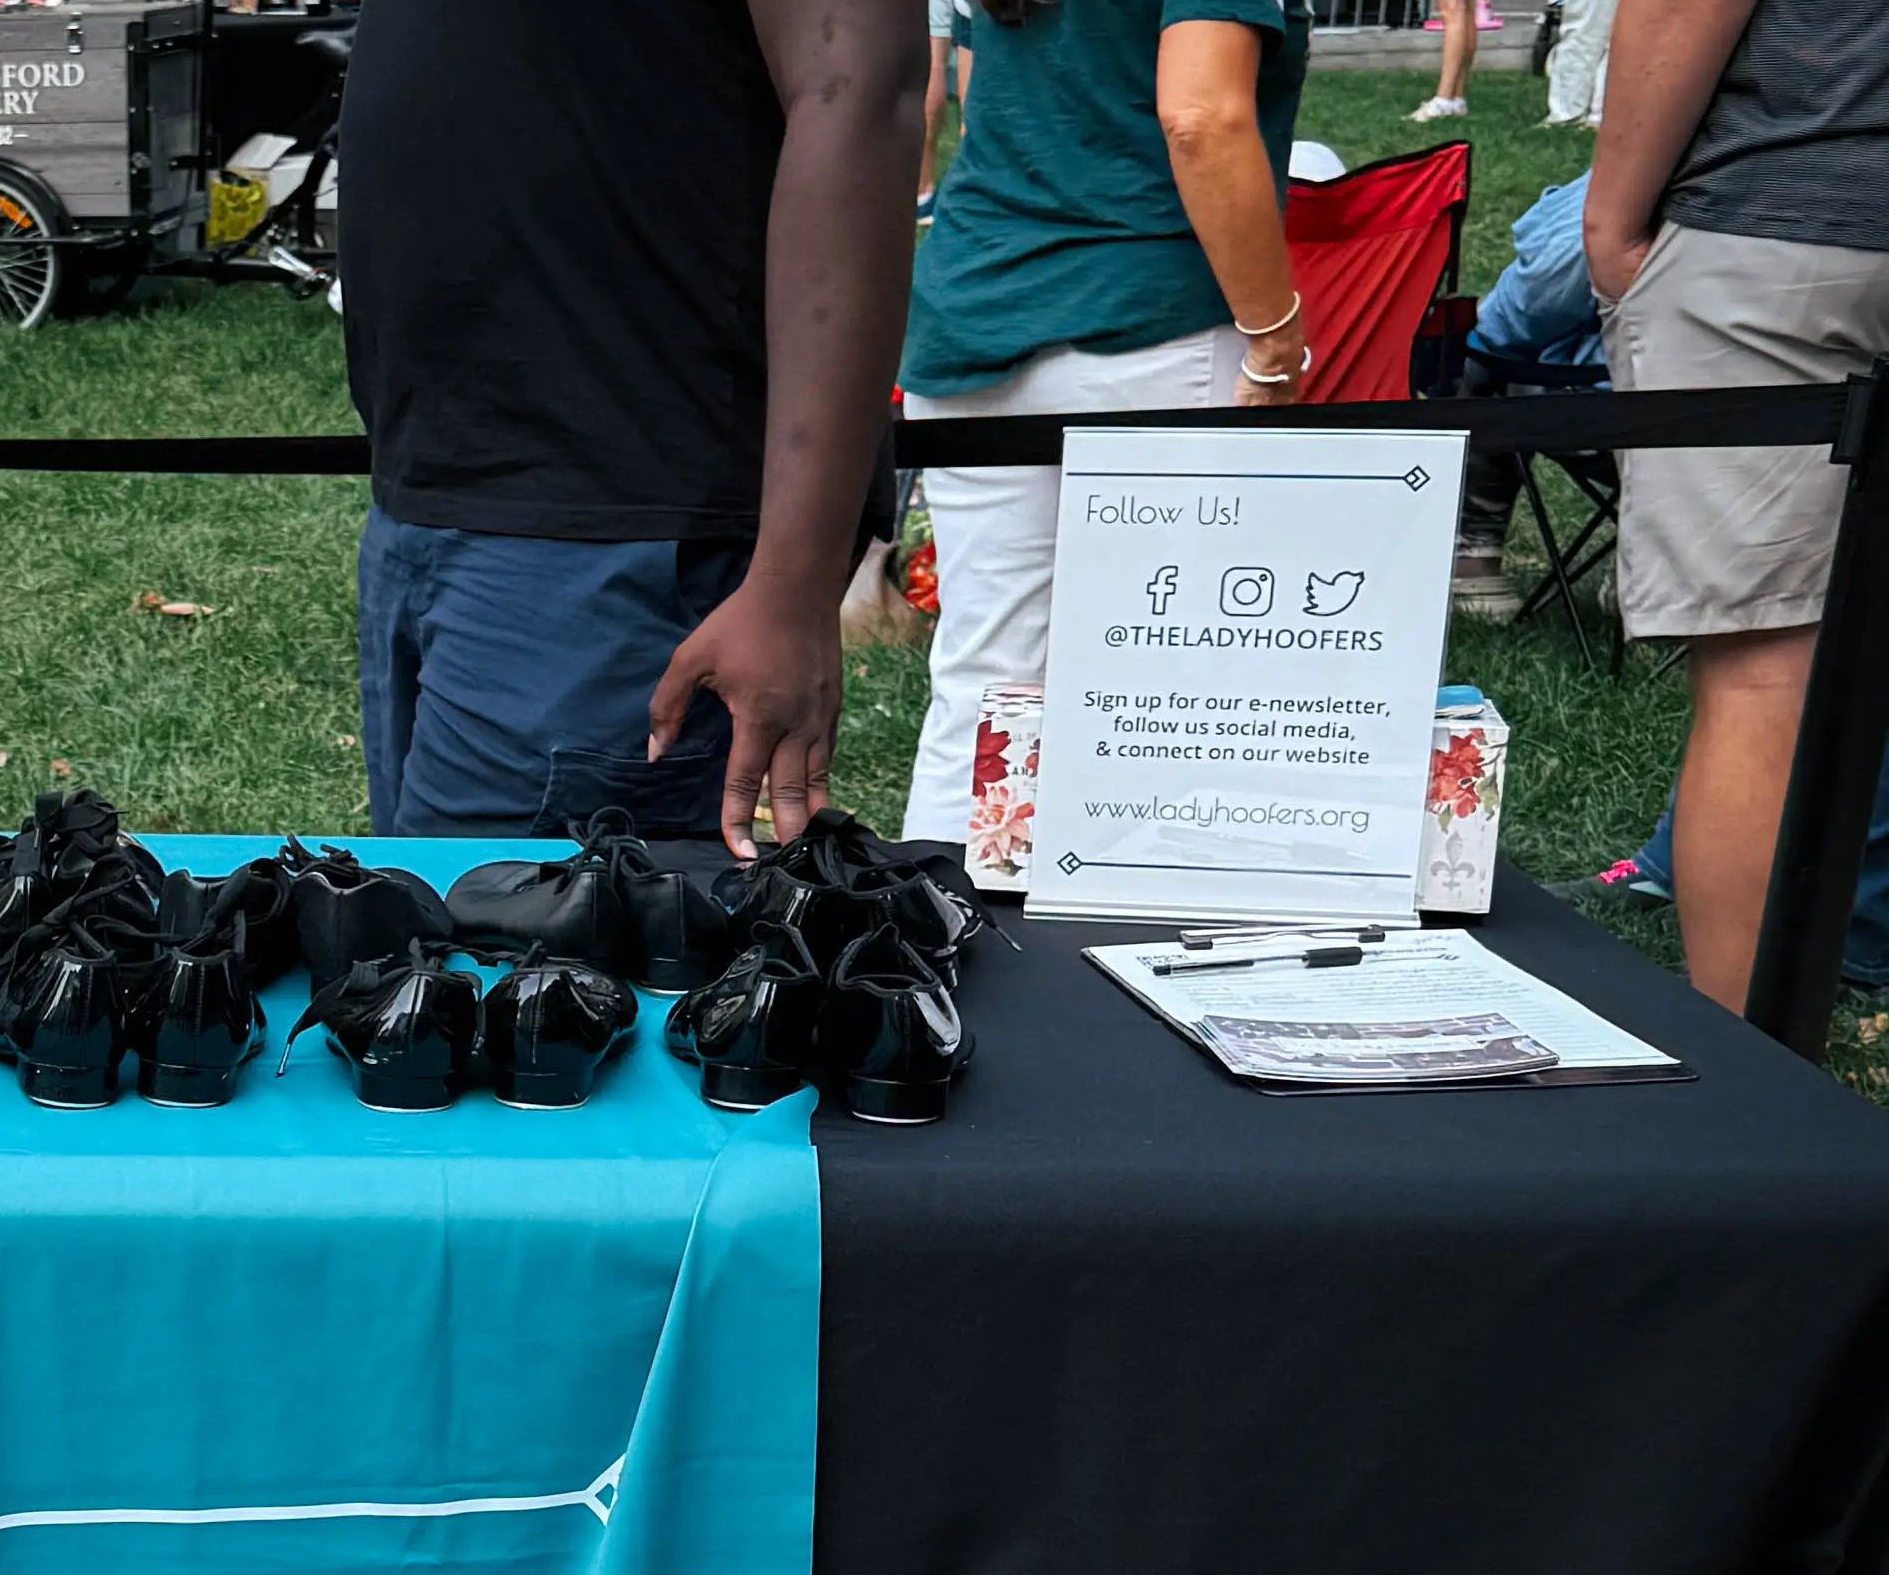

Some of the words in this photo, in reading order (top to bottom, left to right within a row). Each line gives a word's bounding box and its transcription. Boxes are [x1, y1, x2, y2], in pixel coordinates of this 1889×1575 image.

[1086, 494, 1184, 524] Follow
[1197, 496, 1240, 526] Us!
[1104, 625, 1384, 652] @THELADYHOOFERS
[1083, 690, 1128, 713] Sign
[1135, 694, 1162, 713] up
[1168, 692, 1200, 710] for
[1205, 697, 1243, 711] our
[1249, 696, 1392, 718] e-newsletter,
[1113, 715, 1179, 734] follow
[1185, 720, 1209, 736] us
[1215, 719, 1276, 737] social
[1283, 721, 1356, 742] media,
[1095, 741, 1111, 757] &
[1117, 742, 1203, 761] connect
[1208, 746, 1235, 761] on
[1242, 748, 1280, 762] our
[1286, 748, 1370, 765] website
[1084, 795, 1370, 834] www.ladyhoofers.org
